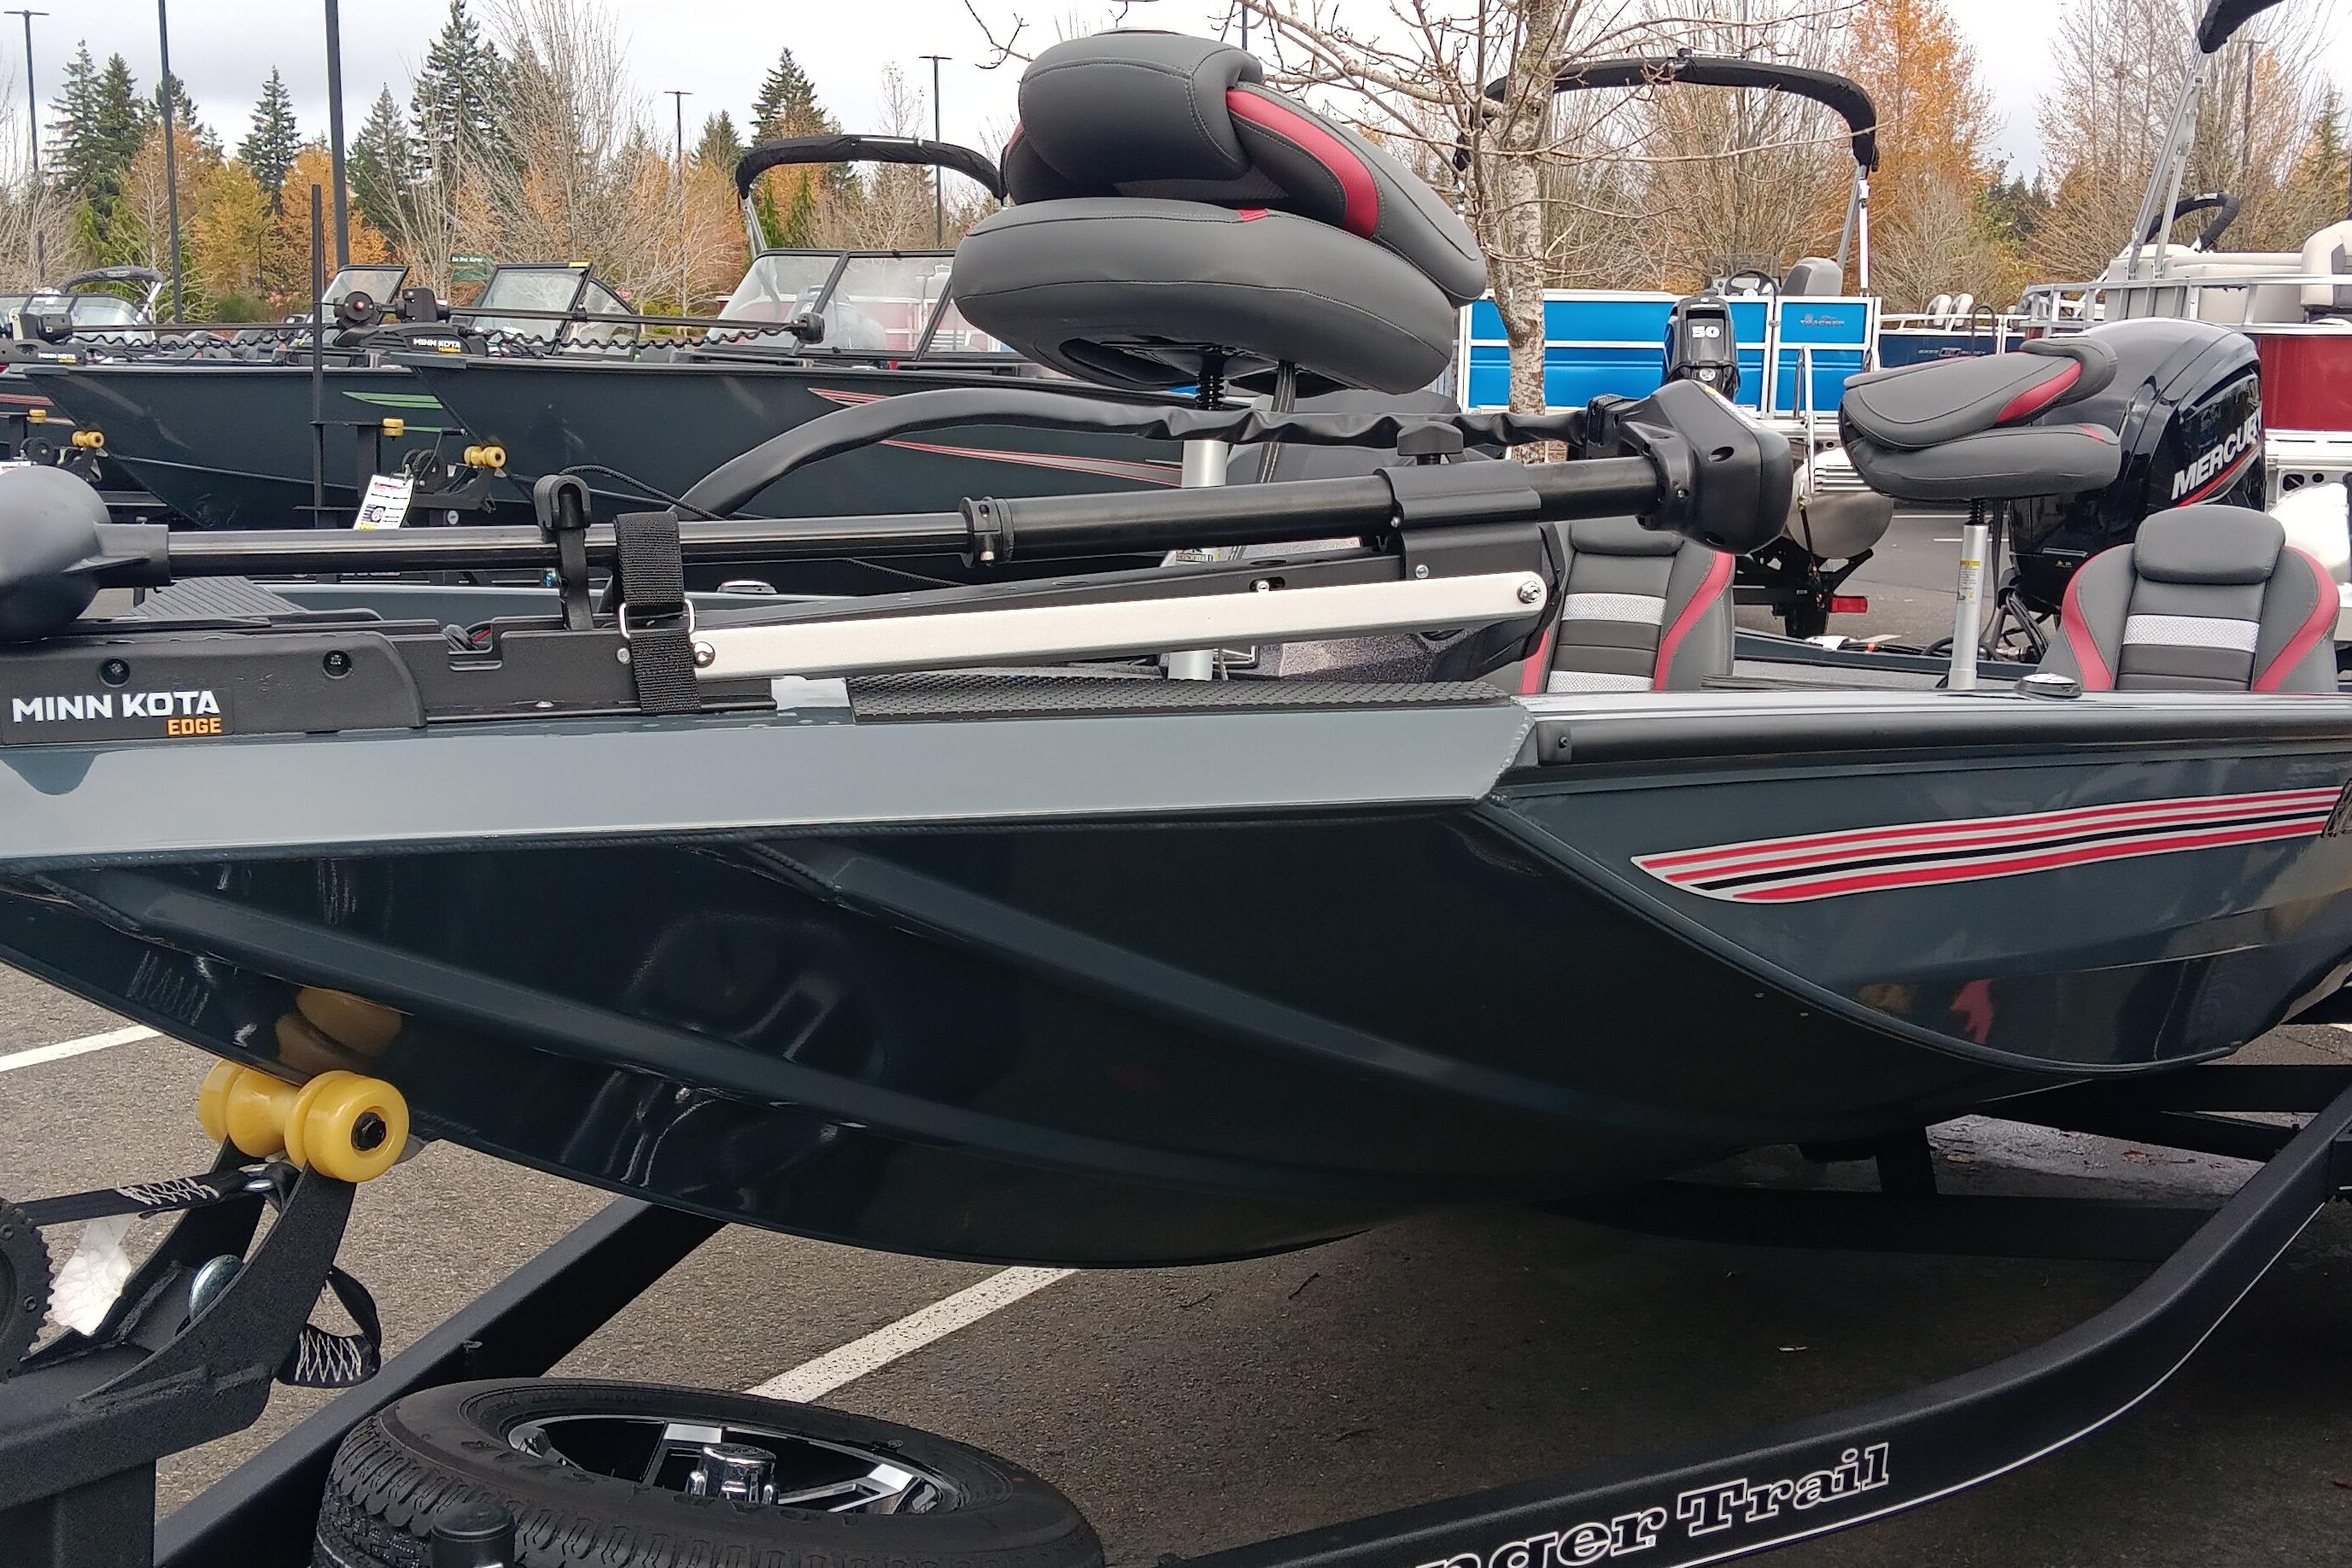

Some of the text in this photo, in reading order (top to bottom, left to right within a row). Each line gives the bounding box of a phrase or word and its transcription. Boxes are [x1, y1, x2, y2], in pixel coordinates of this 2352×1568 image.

[1692, 325, 1720, 338] 50
[413, 338, 460, 348] MINN KOTA
[12, 690, 220, 723] MINN KOTA
[167, 717, 222, 734] EDGE
[1676, 1442, 1889, 1537] Trail
